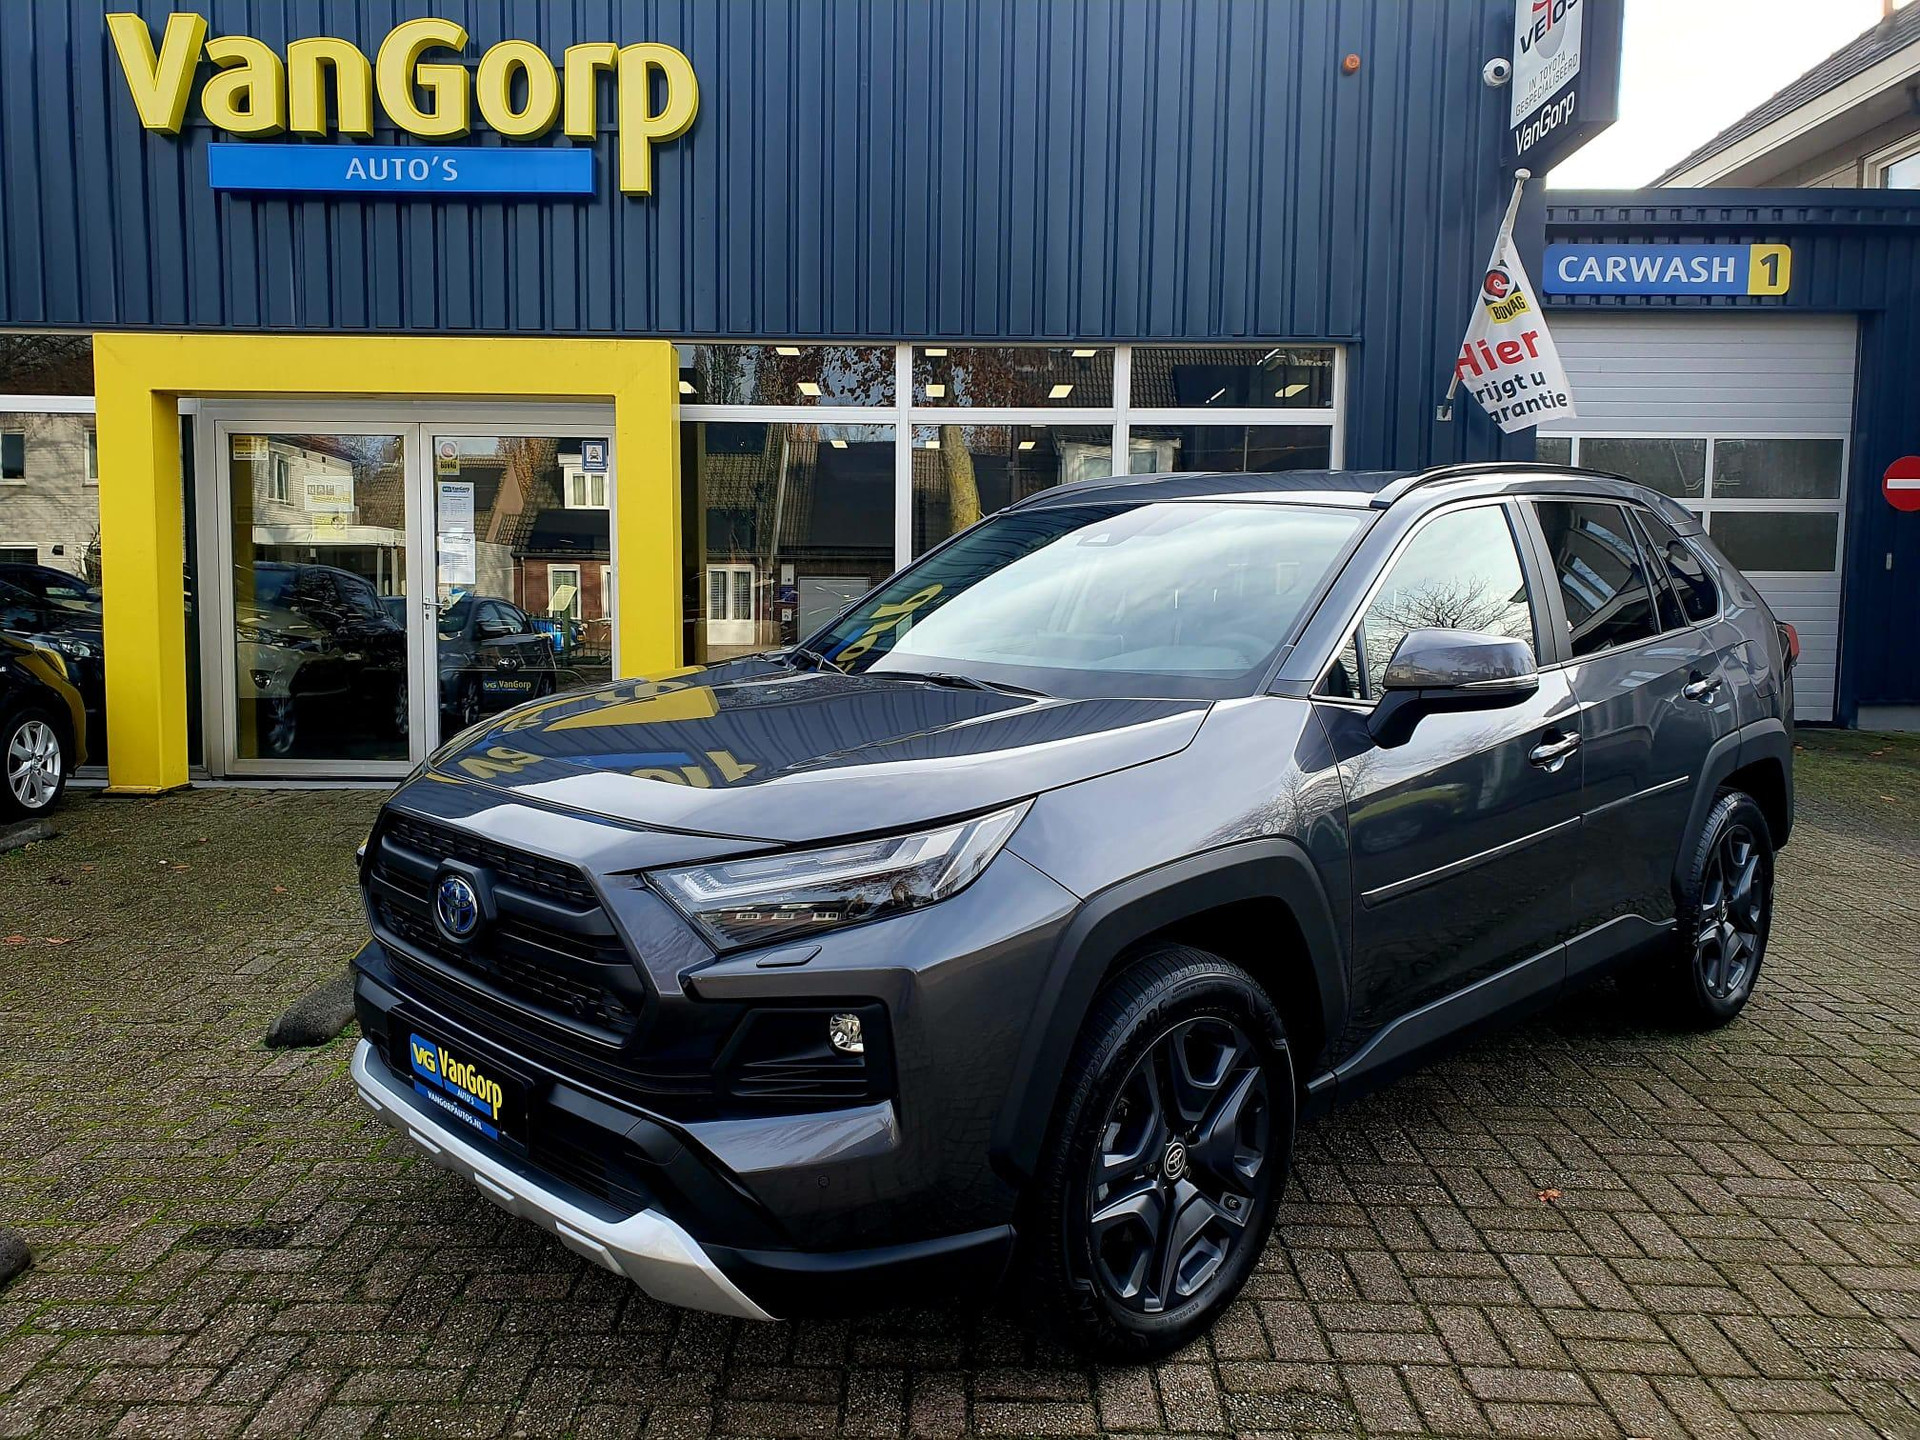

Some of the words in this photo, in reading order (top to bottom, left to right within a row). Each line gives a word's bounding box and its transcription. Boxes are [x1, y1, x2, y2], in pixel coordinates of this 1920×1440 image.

[1515, 53, 1578, 117] GESPECIALISEERD
[1528, 76, 1537, 92] IN
[1540, 50, 1566, 80] TOYOTA
[105, 12, 700, 197] VanGorp
[1515, 91, 1575, 156] VanGorp
[345, 156, 458, 181] AUTO'S
[1558, 256, 1735, 283] CARWASH
[1759, 253, 1779, 287] 1
[1492, 295, 1526, 320] BOVAG
[1455, 330, 1539, 381] Hier
[1472, 374, 1528, 404] rijgt
[1532, 371, 1546, 387] u
[1488, 390, 1568, 424] arantie
[499, 680, 532, 691] VanGorp
[412, 1042, 436, 1072] VG
[438, 1047, 502, 1120] VanGorp
[427, 1090, 483, 1130] VANGORPAUTOS.NL
